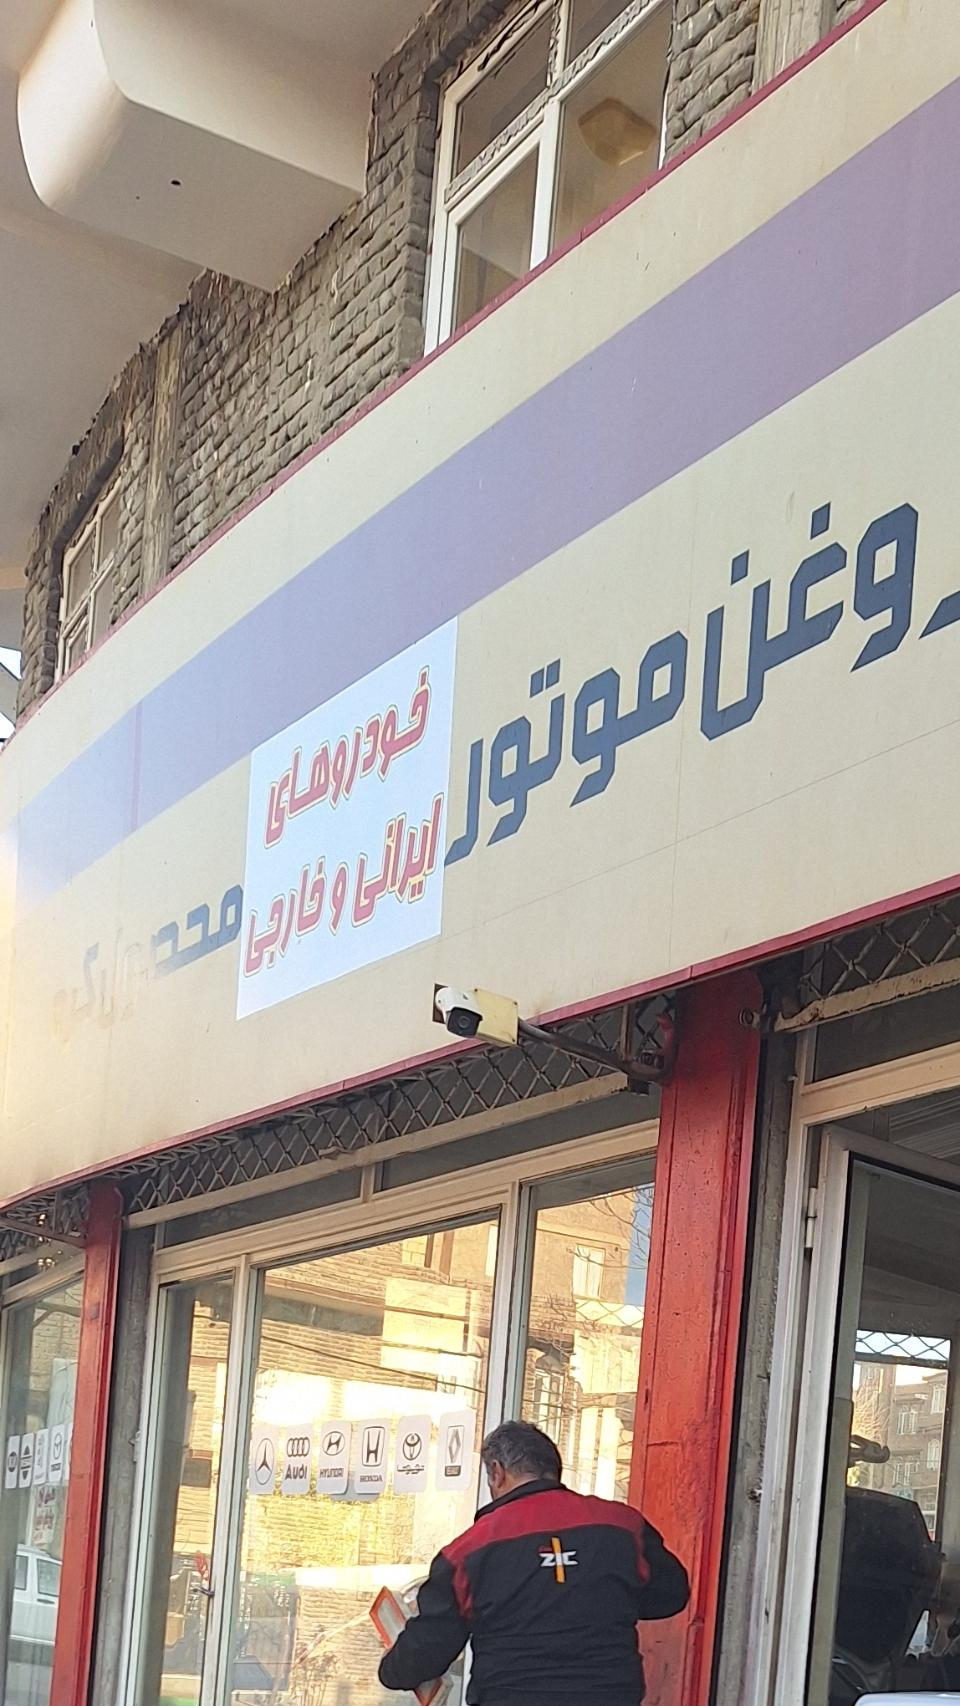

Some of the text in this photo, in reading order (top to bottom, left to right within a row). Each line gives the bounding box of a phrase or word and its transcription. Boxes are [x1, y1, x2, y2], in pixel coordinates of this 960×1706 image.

[264, 664, 432, 849] خودروهای
[444, 630, 688, 868] موتور
[242, 792, 444, 977] ایرانی و خارجی
